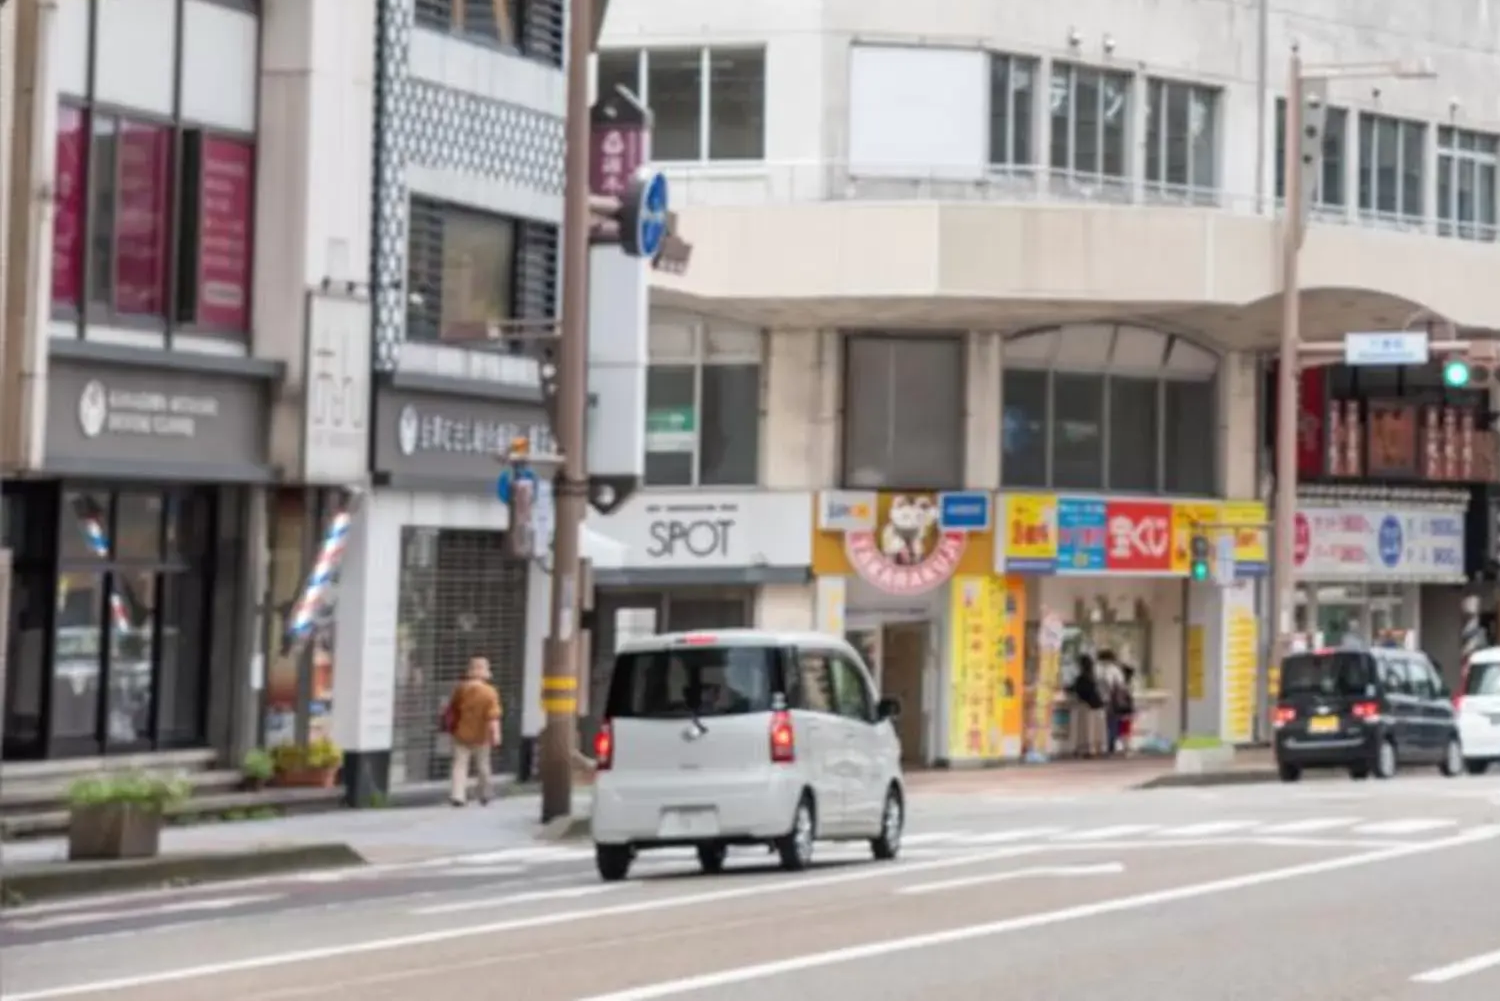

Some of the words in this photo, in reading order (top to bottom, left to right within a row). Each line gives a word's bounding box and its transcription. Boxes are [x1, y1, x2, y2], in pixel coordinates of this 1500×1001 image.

[646, 518, 736, 558] SPOT
[1108, 514, 1169, 559] 宝くじ
